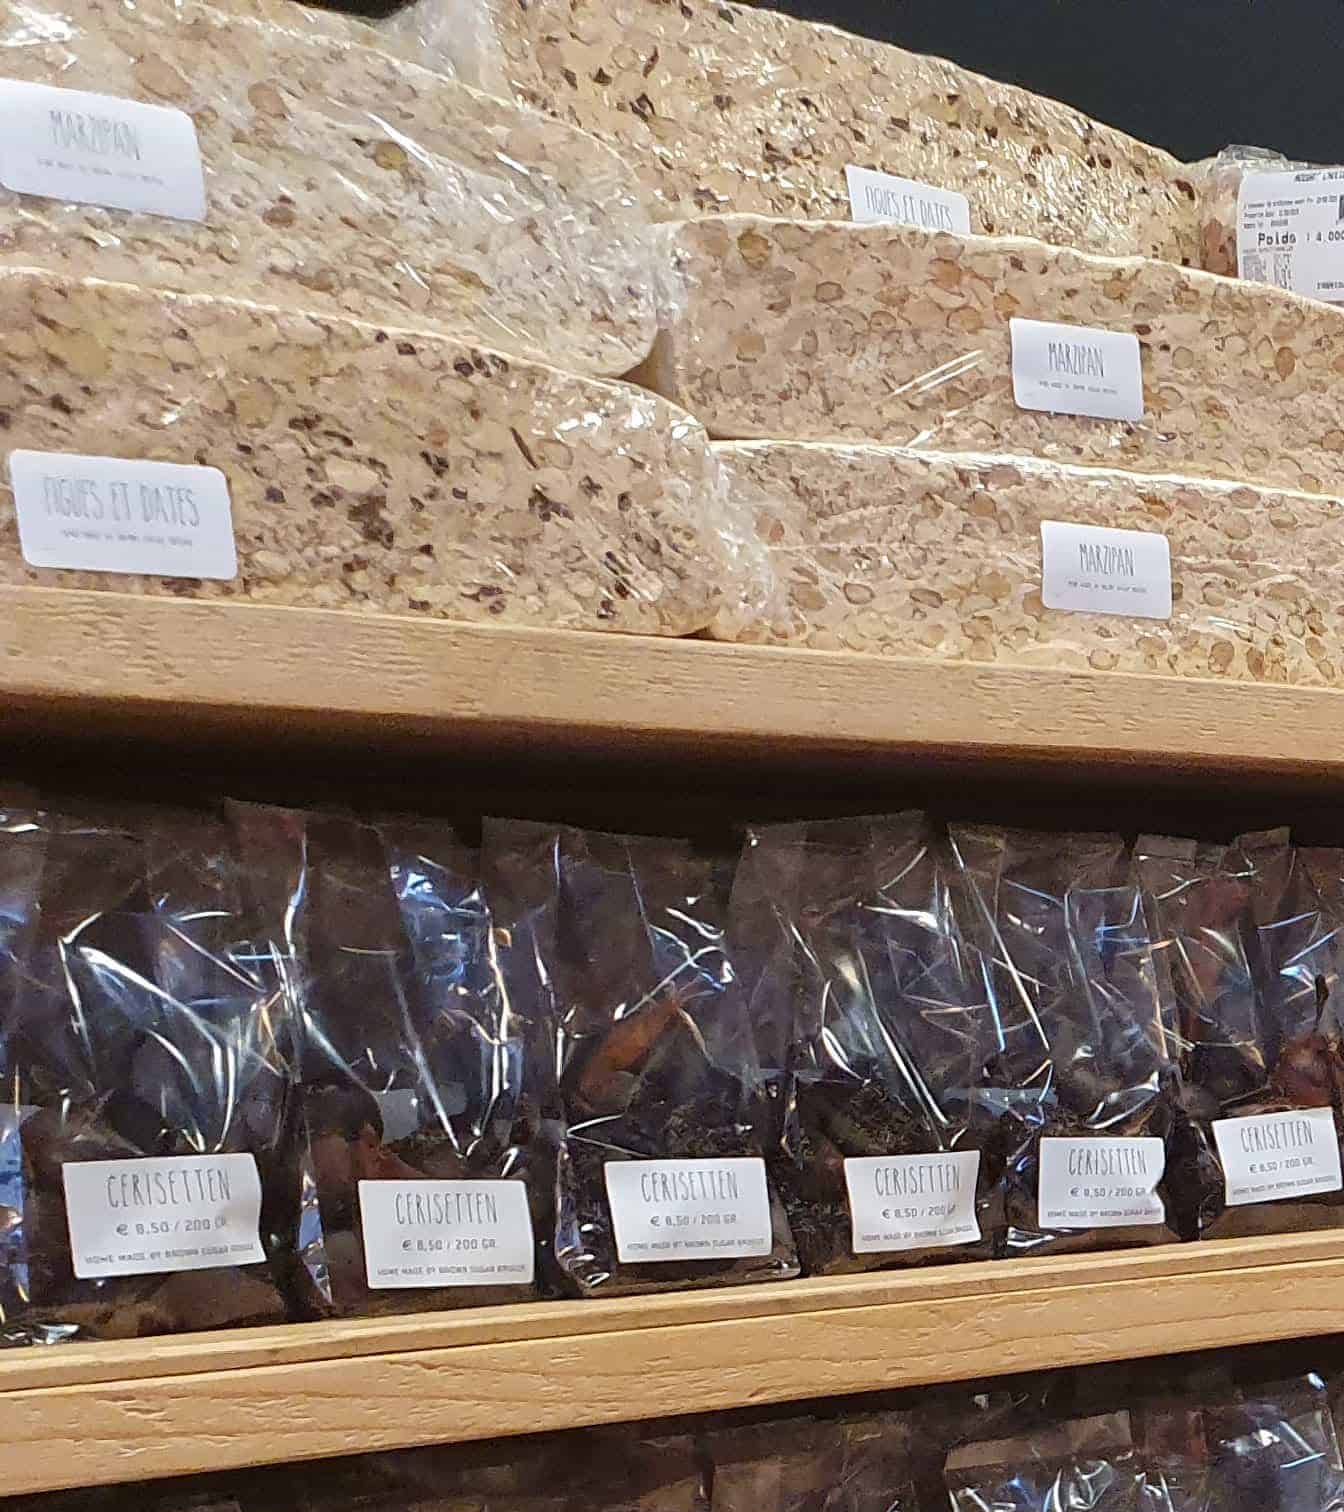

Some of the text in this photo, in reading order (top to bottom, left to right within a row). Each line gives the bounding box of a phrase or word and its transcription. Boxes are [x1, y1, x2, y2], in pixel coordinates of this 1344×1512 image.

[1257, 232, 1297, 247] Poids
[1047, 342, 1104, 378] MARZIPAN
[43, 475, 200, 527] FIGUES ET DATES
[1079, 543, 1134, 577] MARZIPAN
[1240, 1119, 1313, 1153] CERISETTEN
[1068, 1148, 1147, 1177] CERISETTEN
[107, 1169, 231, 1209] CERISETTEN
[641, 1170, 738, 1203] CERISETTEN
[875, 1164, 960, 1197] CERISETTEN
[395, 1192, 498, 1225] CERISETTEN
[116, 1223, 129, 1236] €
[185, 1218, 211, 1232] 200
